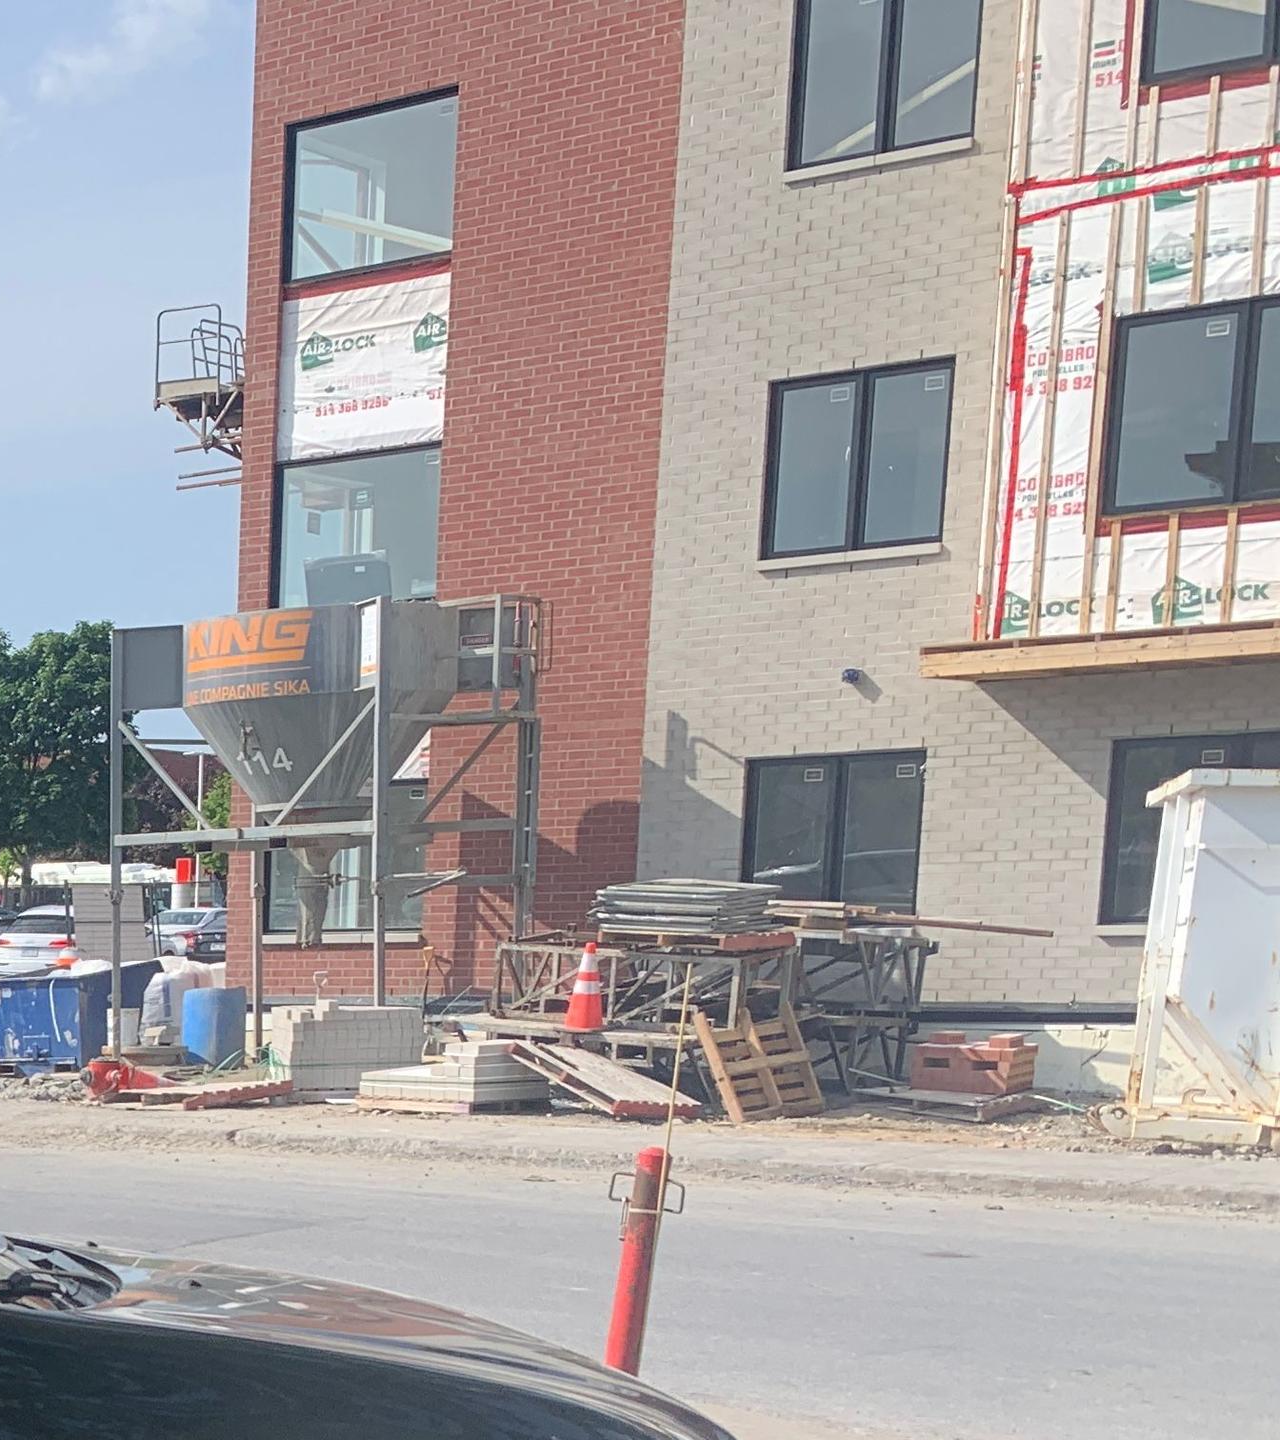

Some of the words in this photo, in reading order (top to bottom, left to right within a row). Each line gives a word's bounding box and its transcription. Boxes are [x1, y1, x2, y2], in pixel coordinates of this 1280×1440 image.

[301, 334, 377, 357] AIR-LOCK
[1039, 378, 1068, 396] 38
[1028, 504, 1058, 518] 38
[188, 610, 314, 658] KING
[201, 682, 271, 703] COMPAGNIE
[273, 679, 311, 696] SIKA
[237, 747, 294, 776] 114
